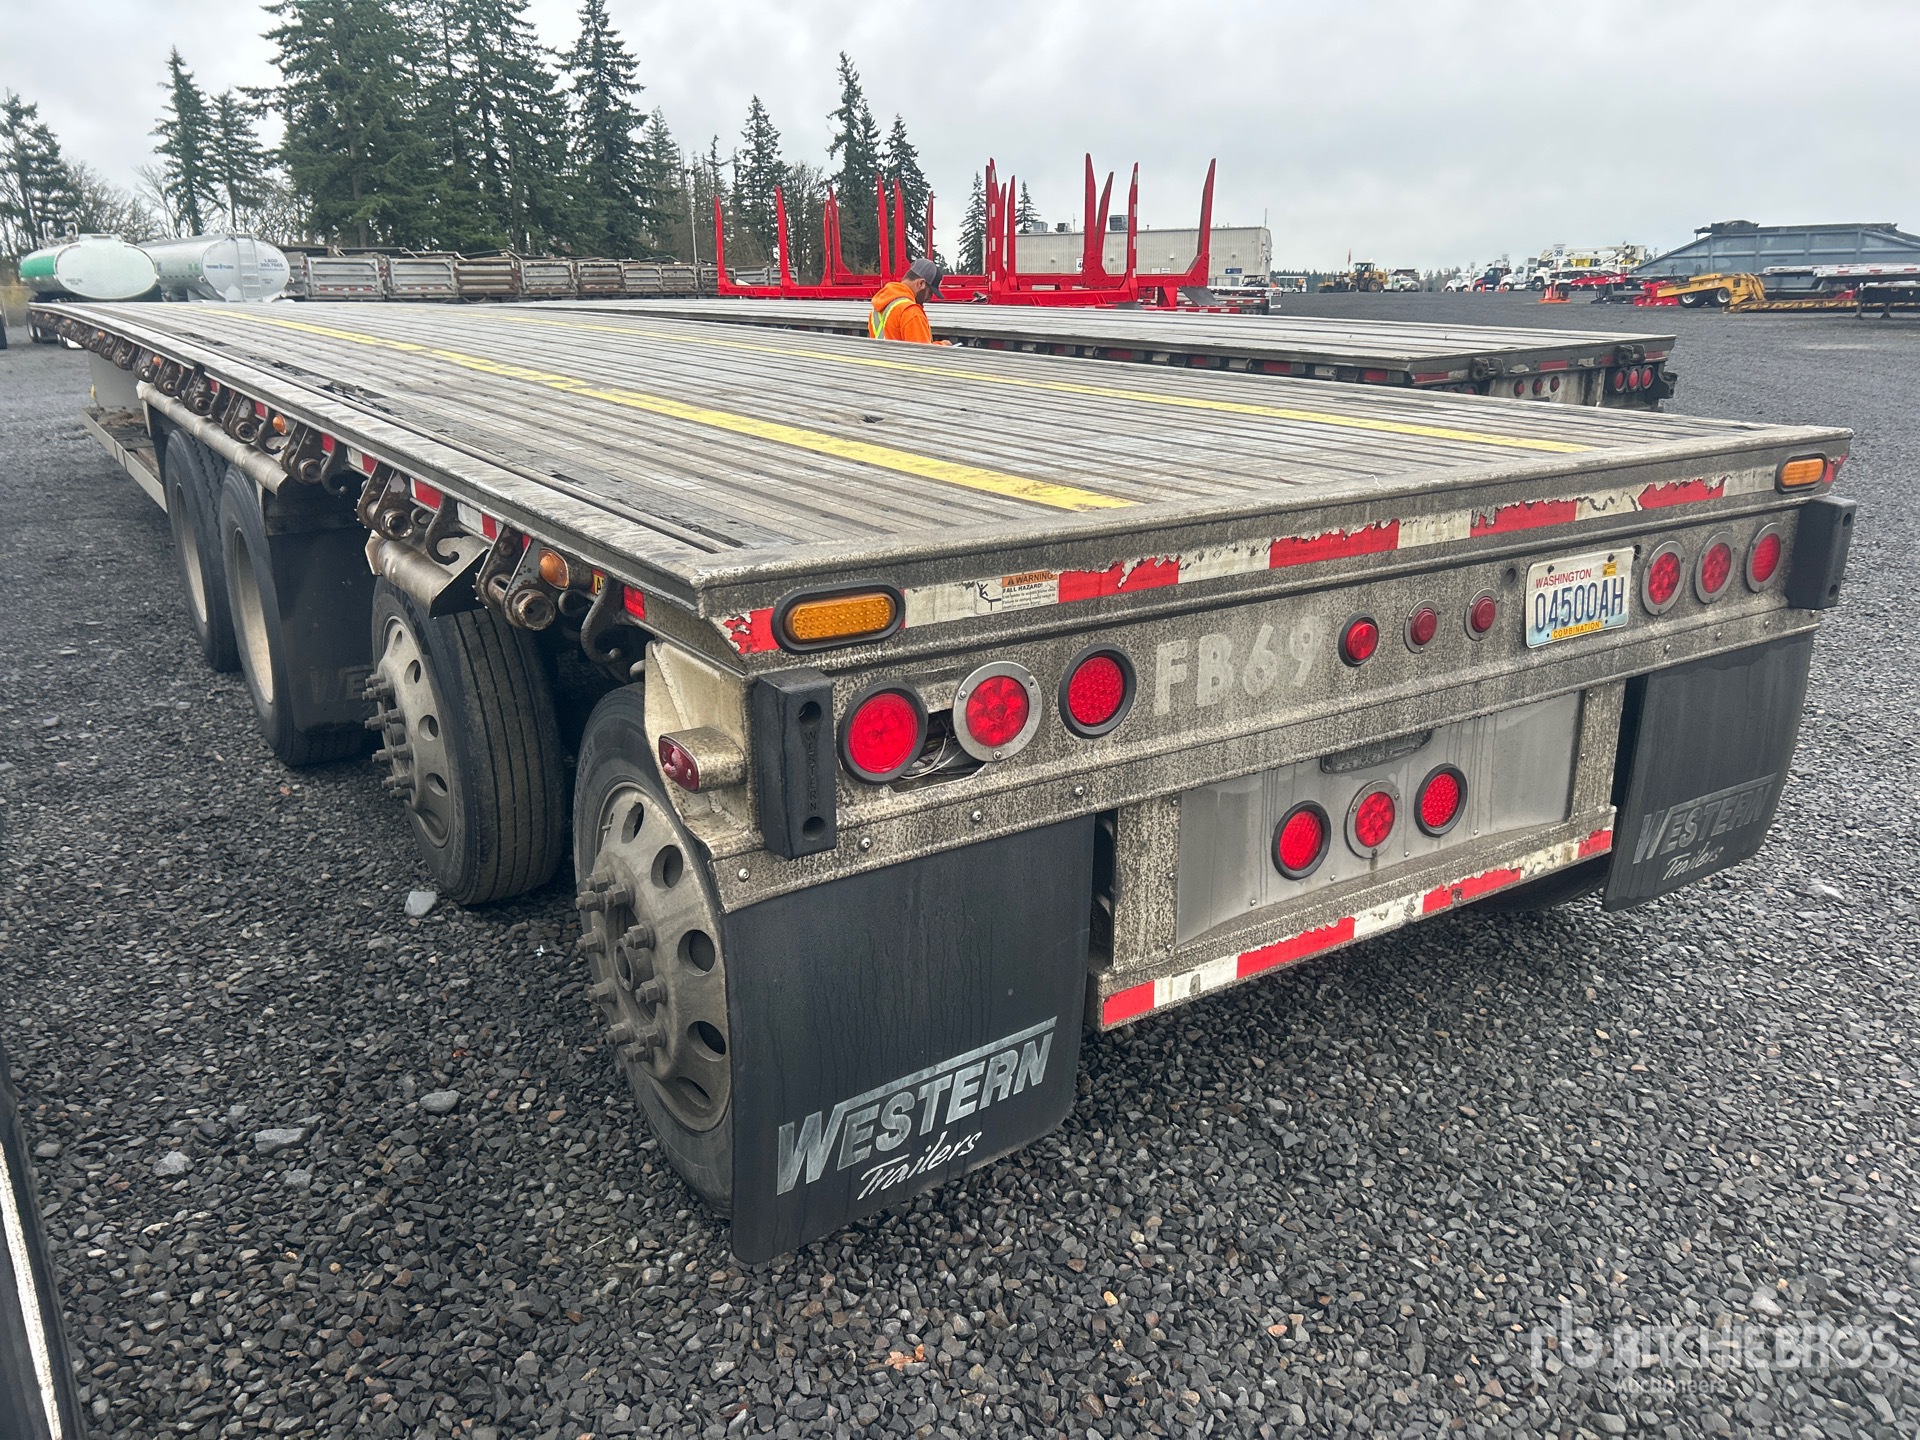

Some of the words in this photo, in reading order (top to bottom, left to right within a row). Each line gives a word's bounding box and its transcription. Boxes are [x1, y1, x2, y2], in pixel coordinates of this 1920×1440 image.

[1554, 249, 1563, 257] 39
[1016, 572, 1053, 584] WARNING
[1535, 568, 1592, 588] WASHINGTON
[1535, 576, 1625, 633] 04500AH
[1553, 622, 1600, 638] COMBINATION
[1154, 615, 1323, 716] FB69
[804, 731, 818, 811] WESTERN
[1633, 773, 1777, 864] WESTERN
[1663, 841, 1724, 880] Trailers
[776, 1016, 1057, 1195] WESTERN
[857, 1131, 982, 1200] Trailers
